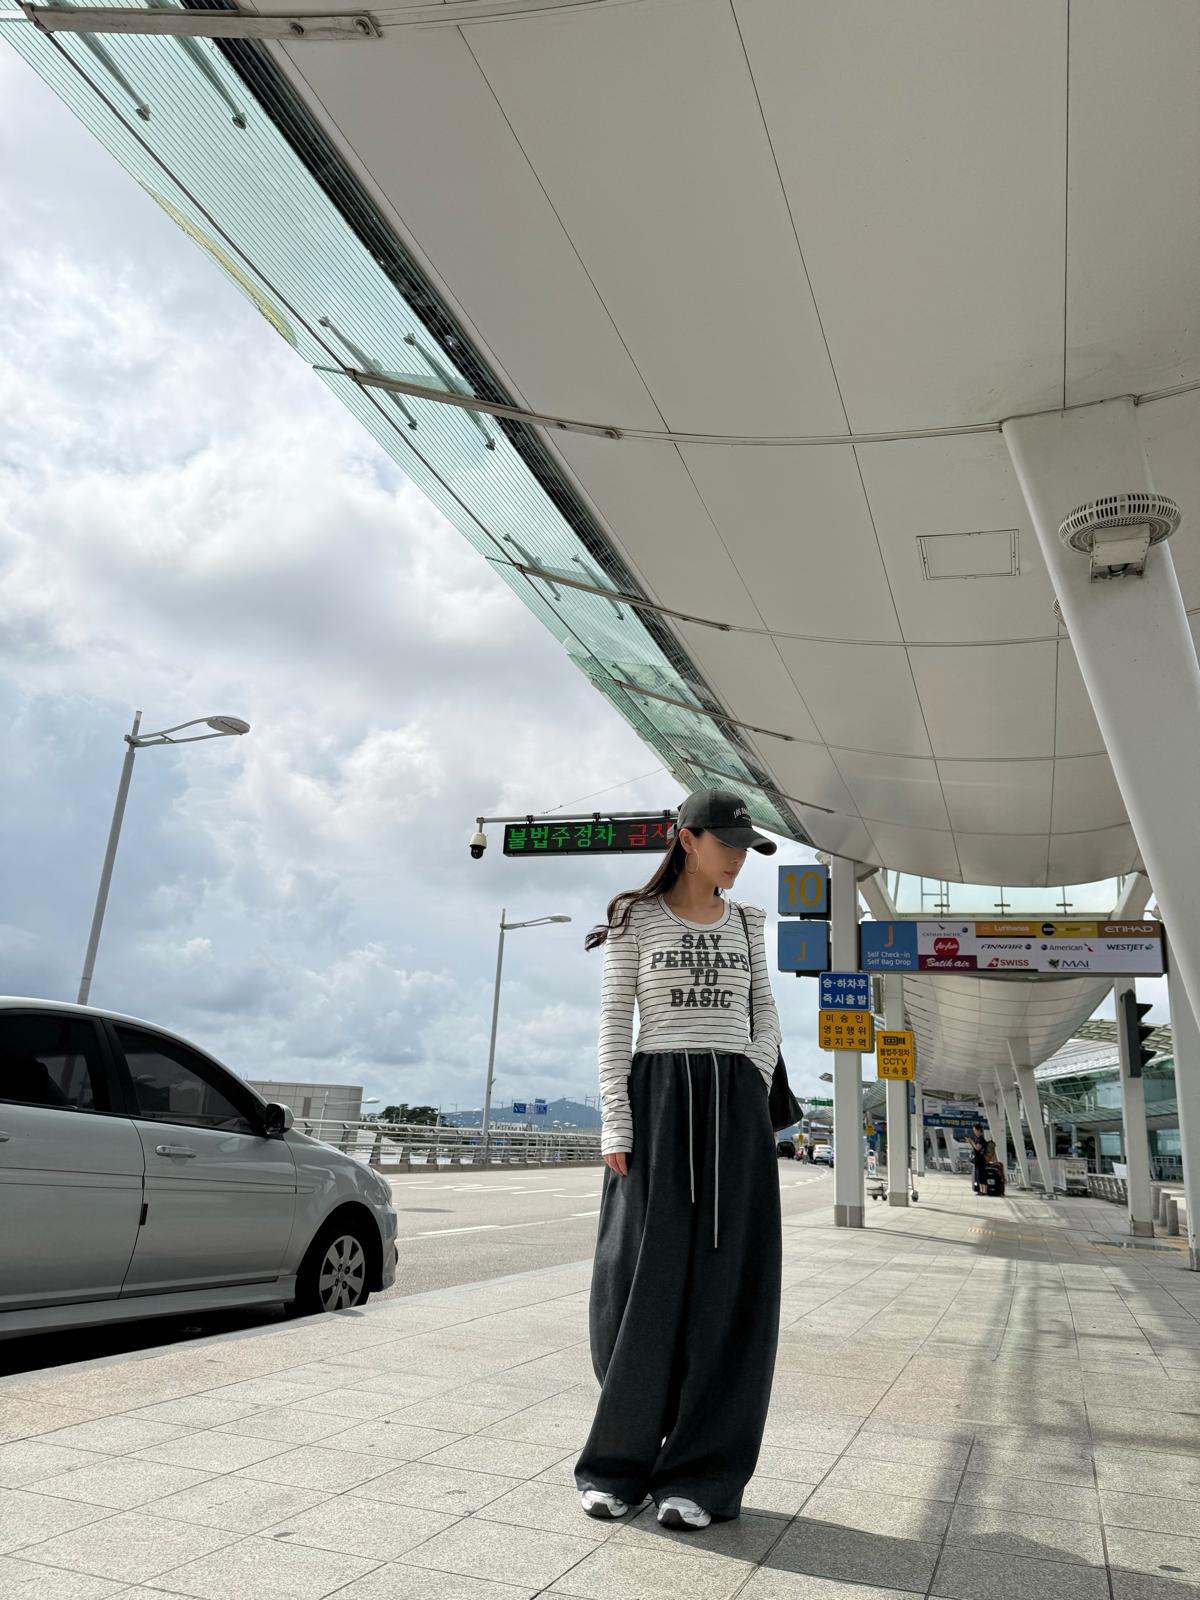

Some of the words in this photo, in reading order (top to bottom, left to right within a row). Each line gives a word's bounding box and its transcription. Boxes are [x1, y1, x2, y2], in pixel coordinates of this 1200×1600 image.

[508, 824, 616, 849] 불법주정차
[783, 871, 822, 907] 10
[883, 926, 894, 948] J
[1104, 925, 1153, 933] ETIHAD
[681, 934, 721, 950] SAY
[1106, 943, 1144, 952] WESTJET
[795, 942, 806, 960] J
[650, 951, 750, 972] PERHAPS
[1000, 959, 1030, 967] SWISS
[1061, 960, 1089, 968] MAI
[690, 968, 719, 986] TO
[670, 988, 733, 1008] BASIC
[823, 993, 867, 1005] 즉시출발
[882, 1057, 908, 1065] CCTV
